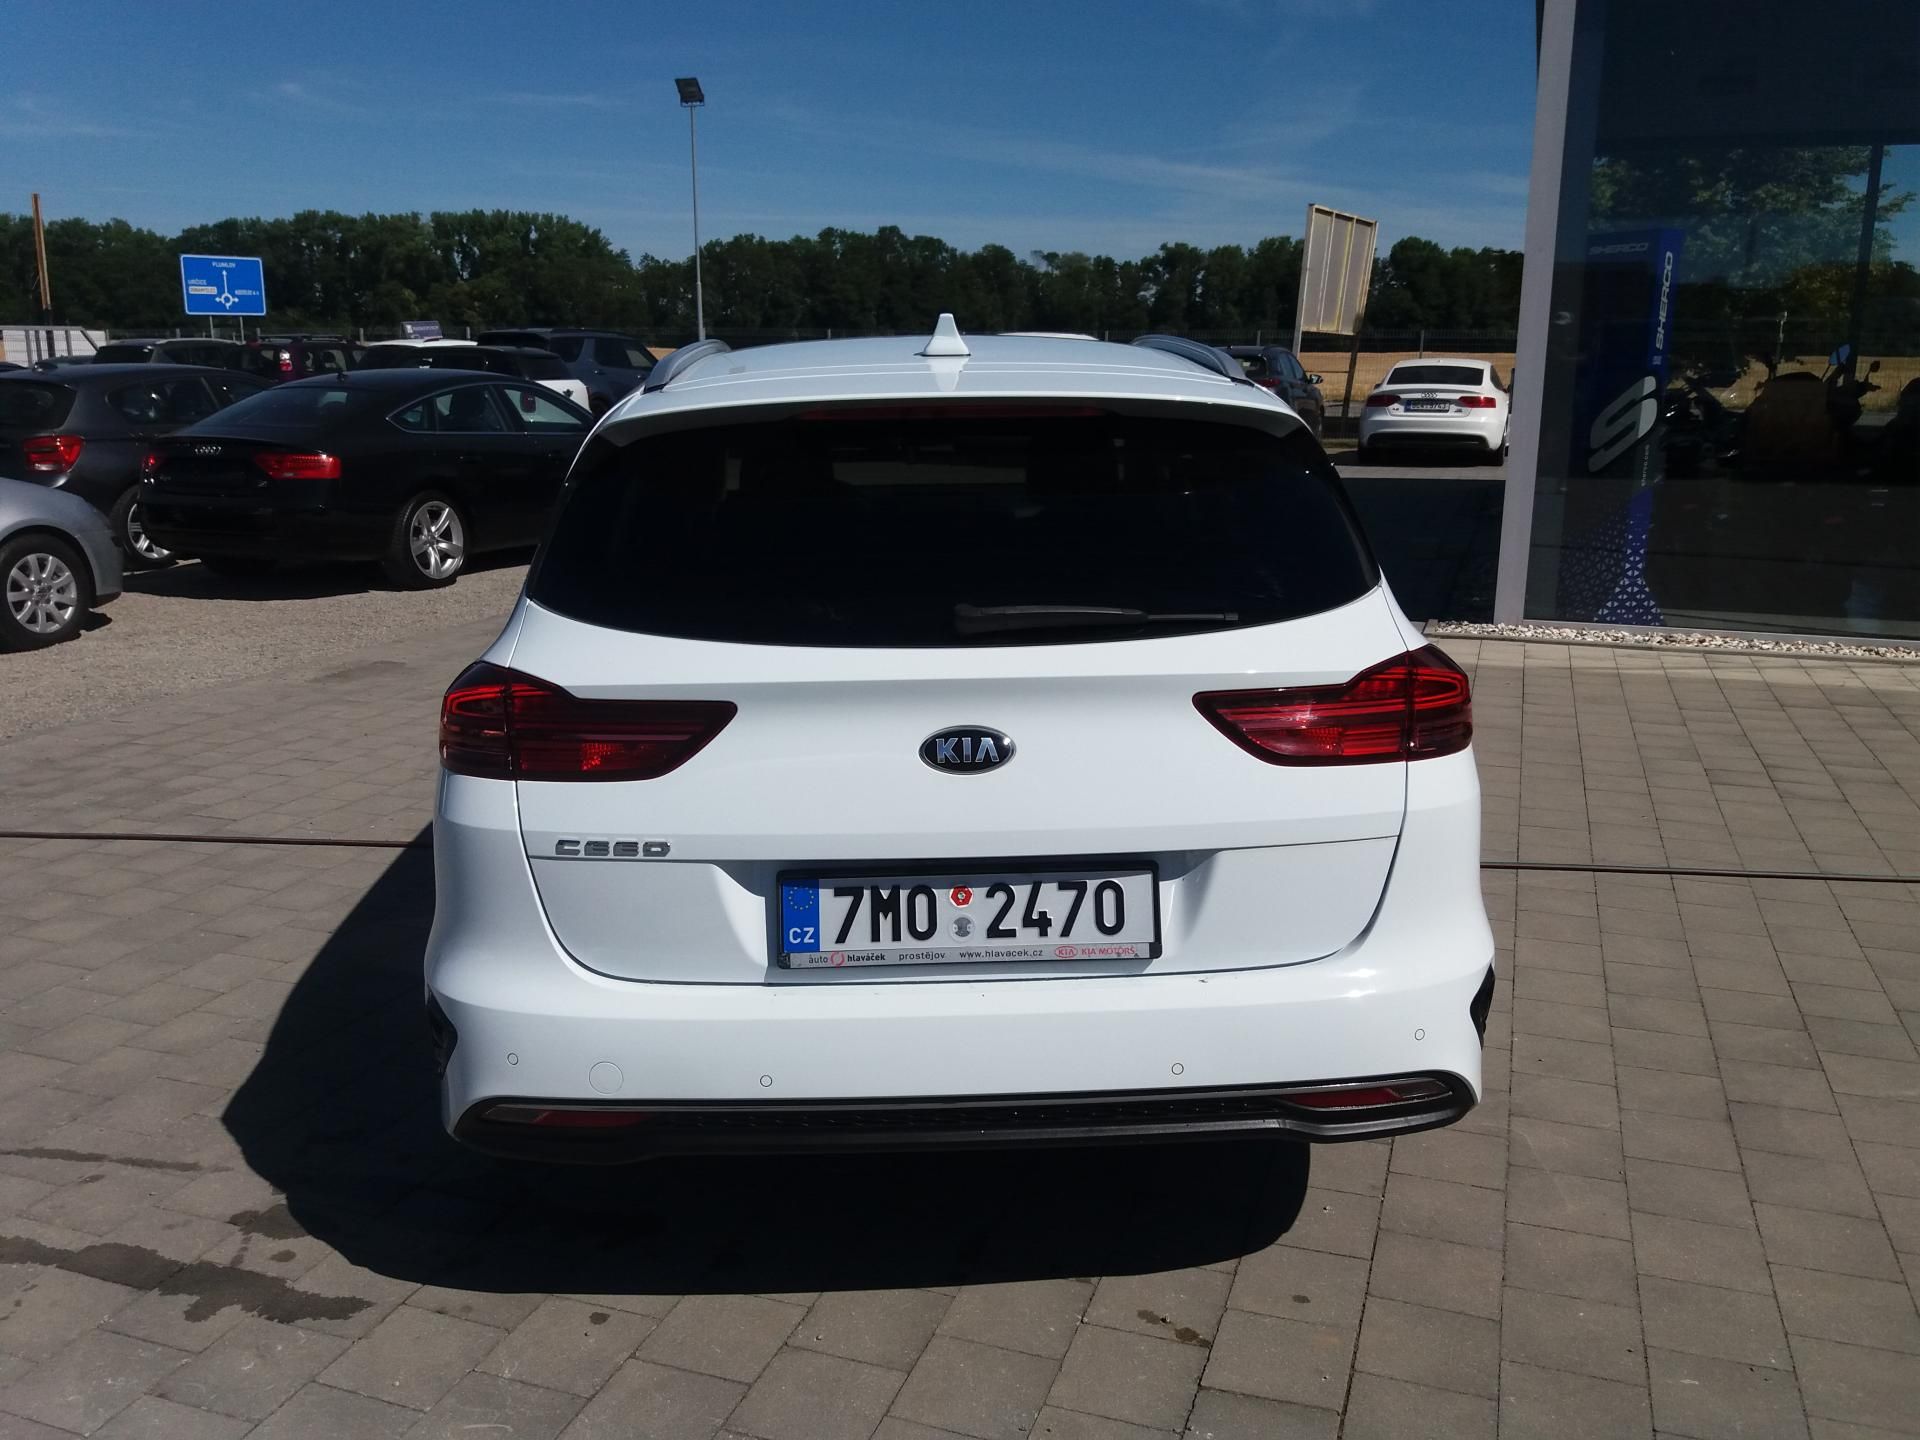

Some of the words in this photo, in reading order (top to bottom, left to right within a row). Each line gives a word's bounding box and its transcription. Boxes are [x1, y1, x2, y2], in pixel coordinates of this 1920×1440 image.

[1656, 251, 1673, 350] SHERCO
[935, 737, 1000, 764] KIA
[555, 839, 671, 857] CEED
[985, 880, 1126, 938] 2470
[789, 927, 815, 943] CZ
[808, 953, 828, 964] auto
[847, 950, 886, 962] hlaváček
[898, 951, 946, 961] prostějov
[959, 948, 1043, 959] www.hlavacek.cz
[1081, 948, 1097, 956] KIA
[1098, 946, 1136, 956] MOTORS
